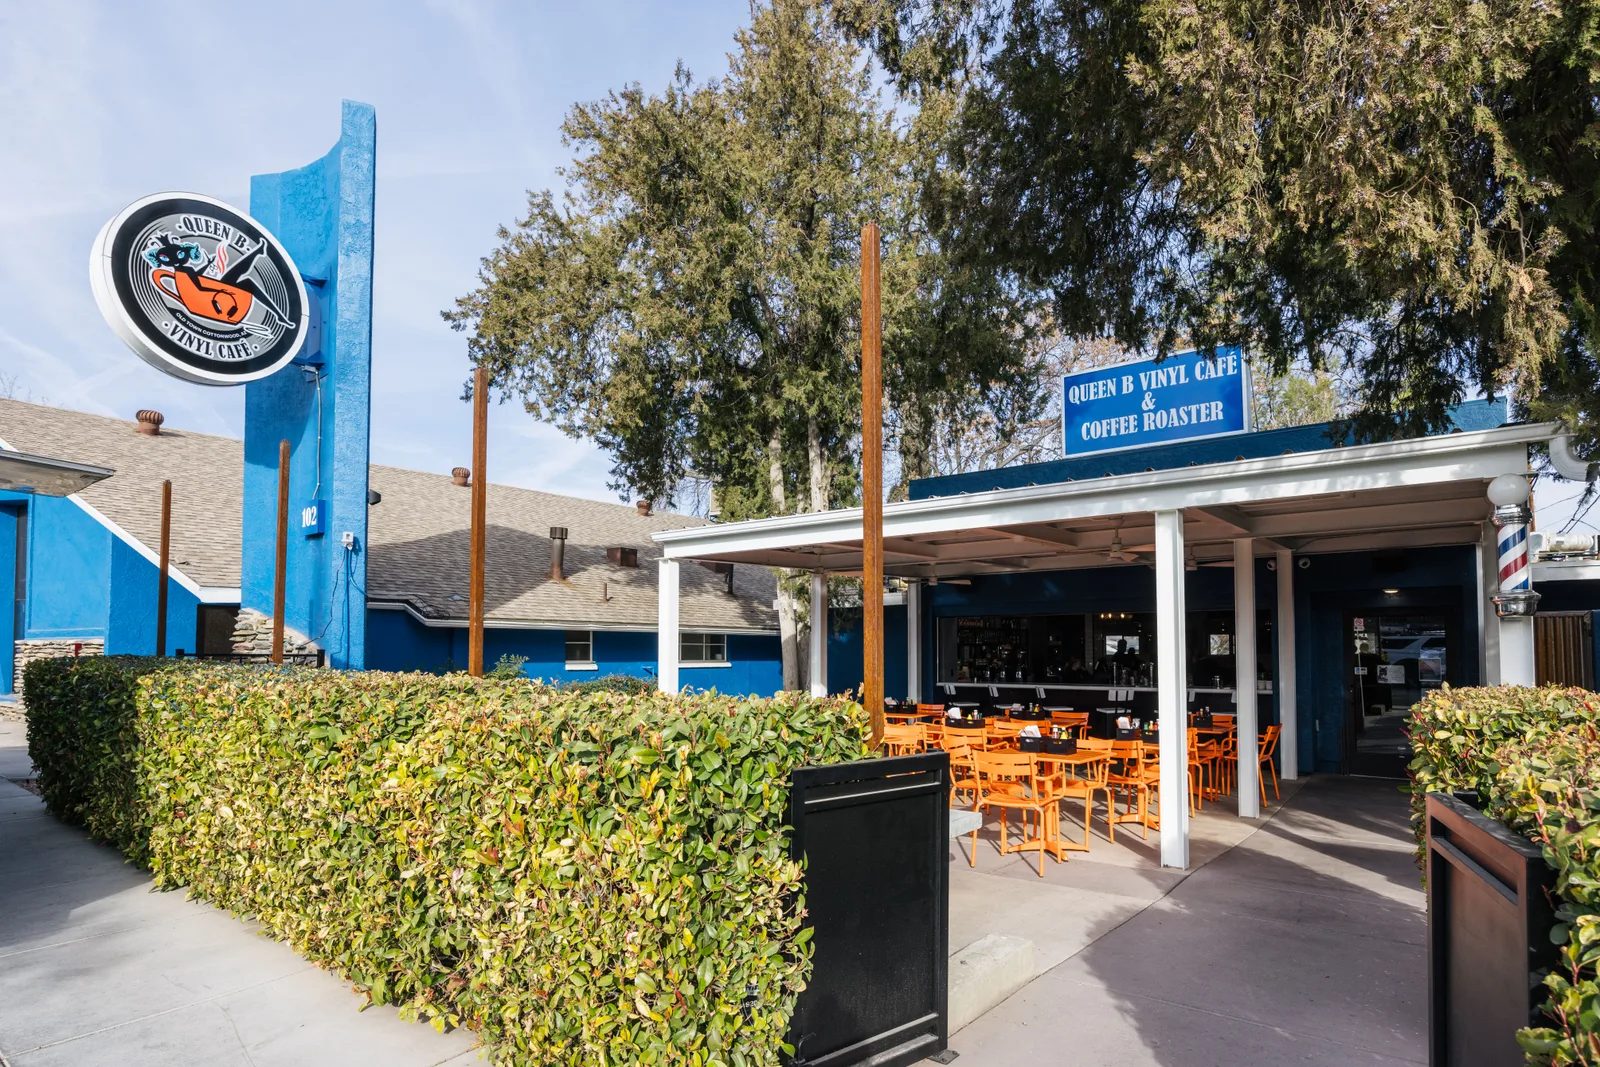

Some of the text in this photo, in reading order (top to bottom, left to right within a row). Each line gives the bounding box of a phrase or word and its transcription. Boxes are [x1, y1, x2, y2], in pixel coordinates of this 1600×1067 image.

[182, 216, 231, 241] QUEEN
[175, 312, 187, 323] OLD
[186, 320, 203, 333] TOWN
[202, 330, 242, 339] COTTONWOOD,
[170, 323, 253, 359] VINYL CAFÉ
[1068, 351, 1238, 405] QUEEN B VINYL CAFÉ
[1141, 391, 1156, 411] &
[1081, 400, 1224, 441] COFFEE ROASTER
[301, 505, 317, 528] 102
